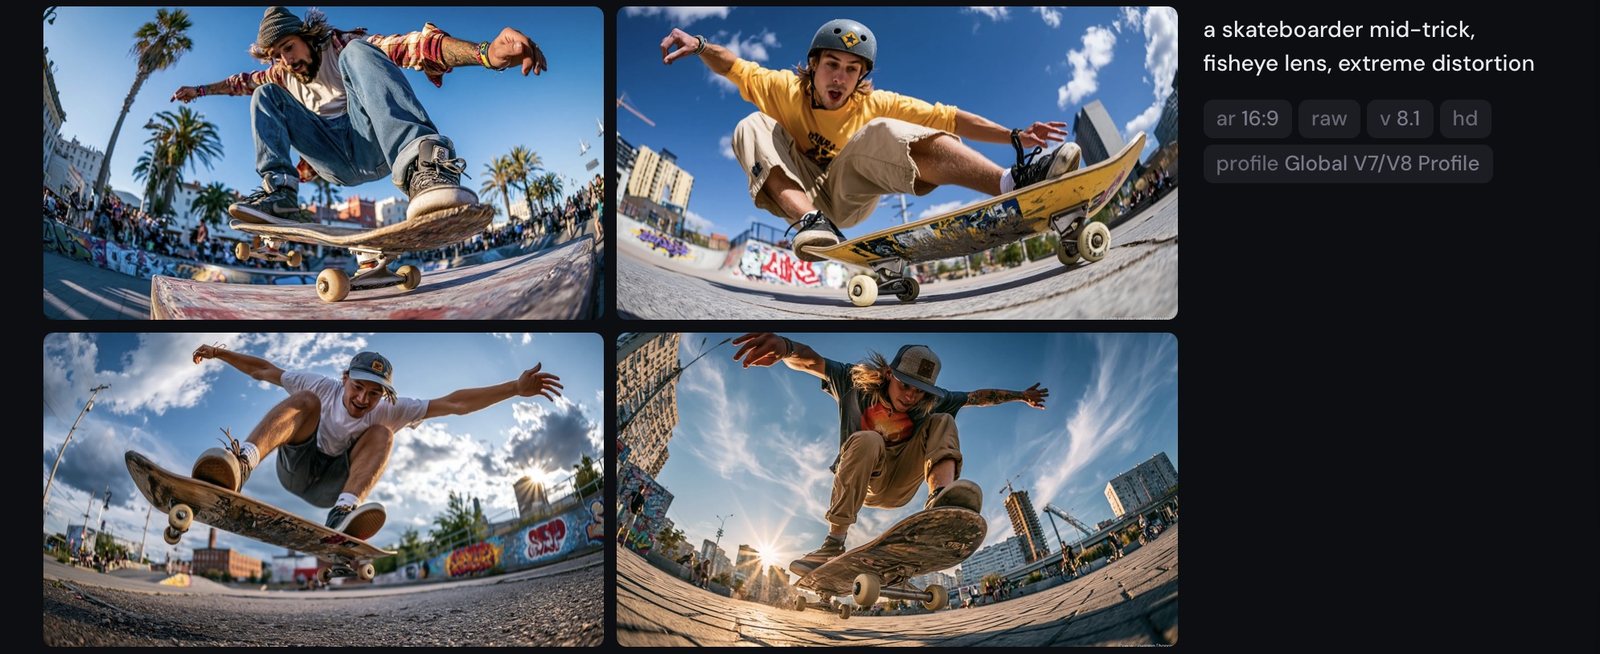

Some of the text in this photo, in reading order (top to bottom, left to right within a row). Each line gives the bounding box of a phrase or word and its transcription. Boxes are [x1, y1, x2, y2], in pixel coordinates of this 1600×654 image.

[1203, 19, 1475, 41] a skateboarder mid-trick,
[1203, 53, 1535, 77] fisheye lens, extreme distortion
[1216, 109, 1279, 127] ar 16:9
[1312, 113, 1348, 127] raw
[1379, 109, 1420, 127] v 8.1
[1453, 109, 1478, 127] hd
[1216, 153, 1480, 176] profile Global V7/V8 Profile
